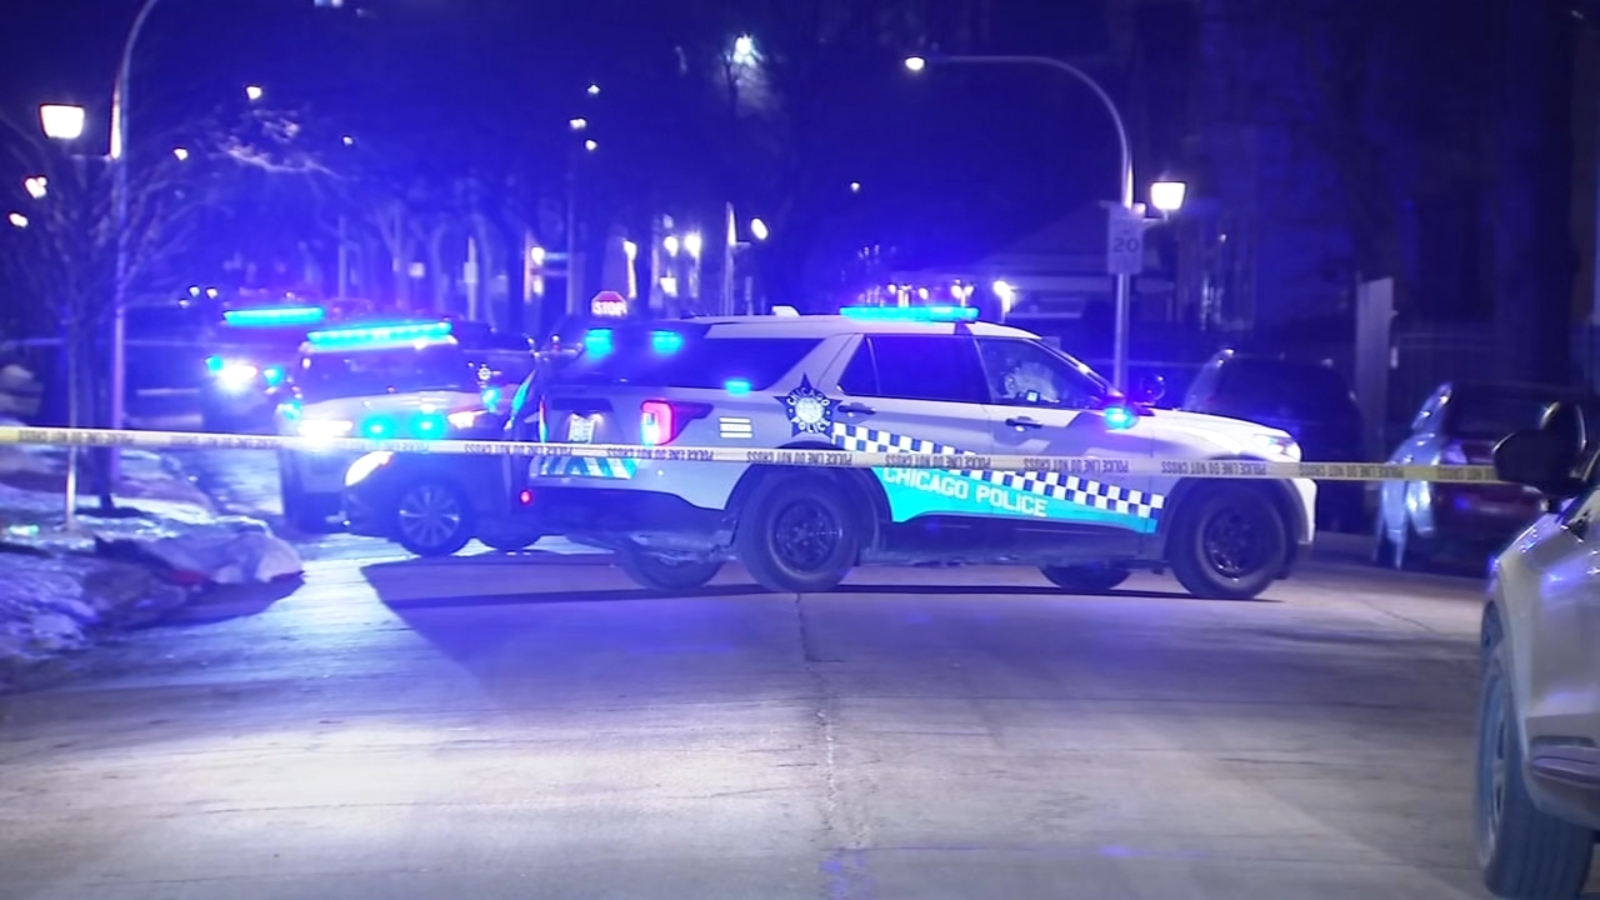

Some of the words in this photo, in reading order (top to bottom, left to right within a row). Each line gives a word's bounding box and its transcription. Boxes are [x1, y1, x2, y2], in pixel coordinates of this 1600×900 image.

[1113, 238, 1139, 253] 20
[593, 301, 625, 317] STOP
[786, 386, 830, 407] CHICAGO
[791, 417, 831, 434] POLICE
[825, 453, 852, 465] POLICE
[883, 467, 969, 500] CHICAGO
[976, 484, 1049, 517] POLICE
